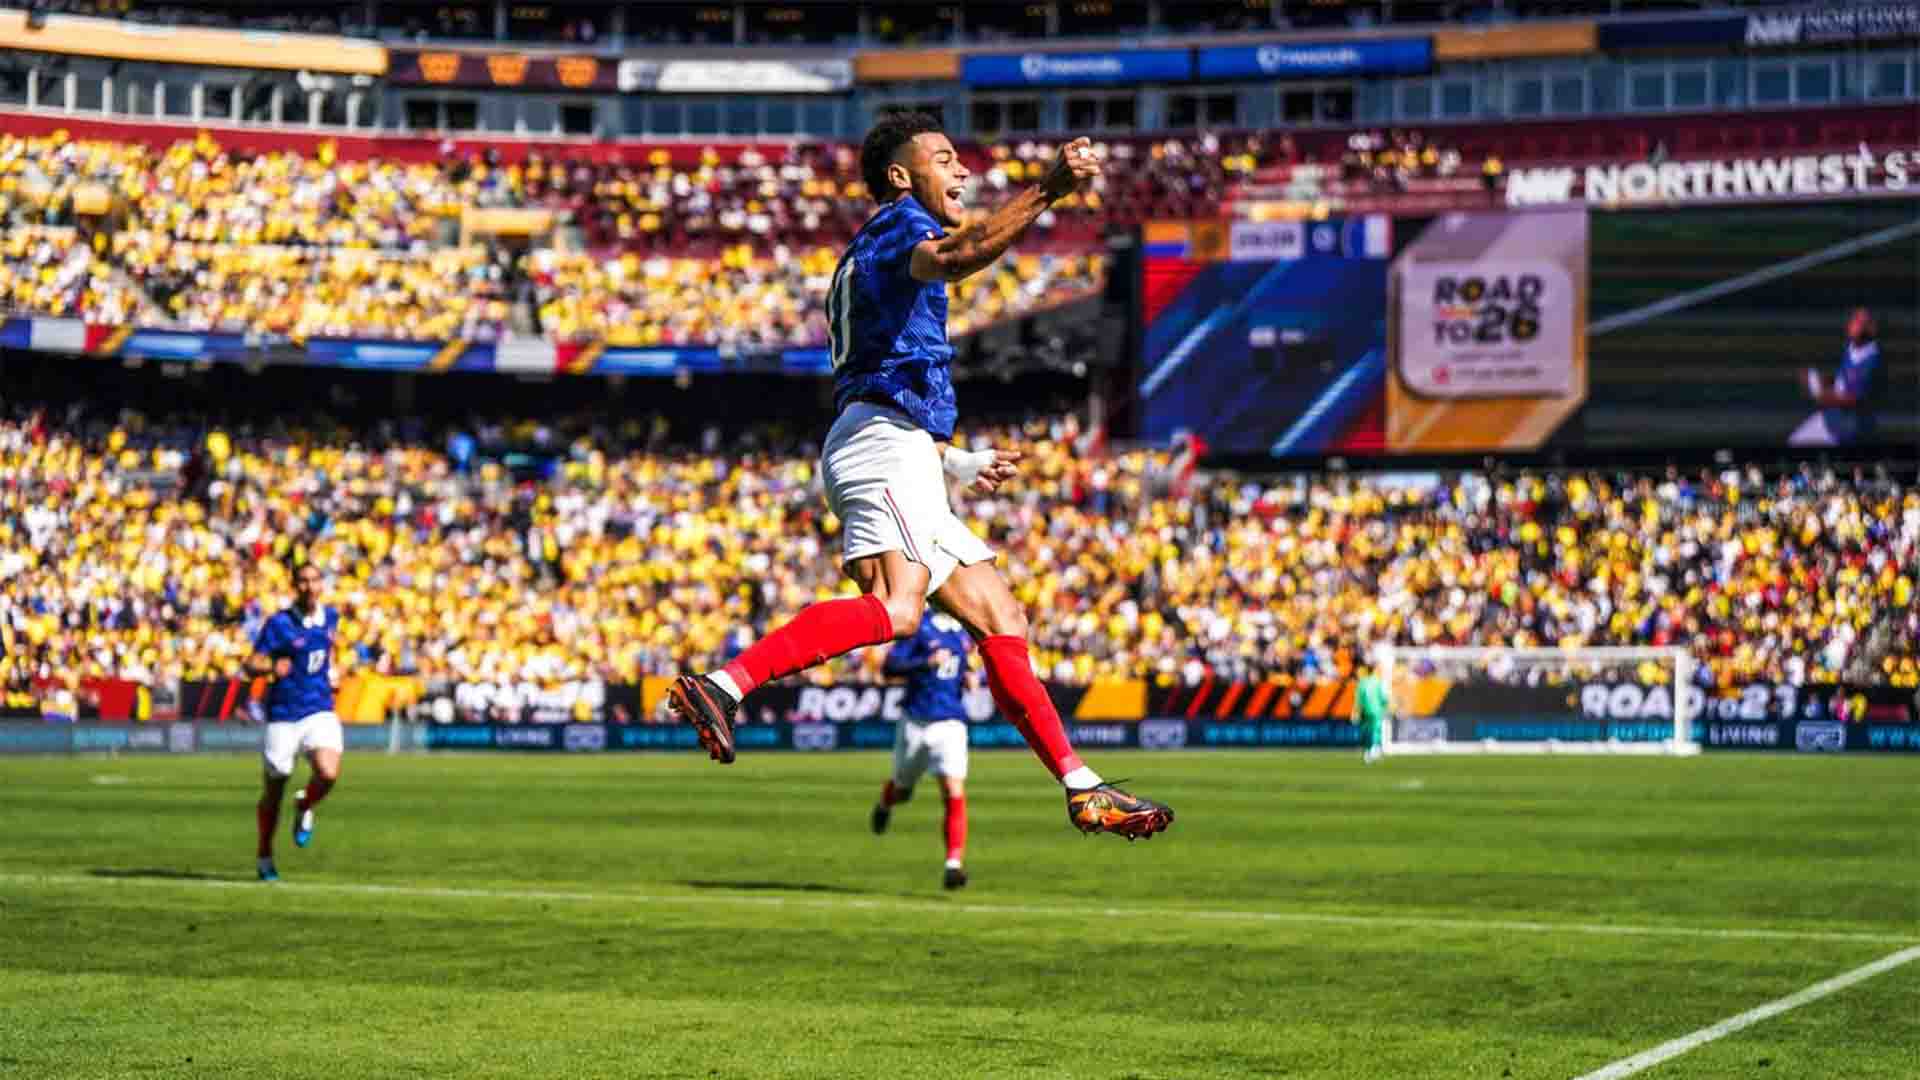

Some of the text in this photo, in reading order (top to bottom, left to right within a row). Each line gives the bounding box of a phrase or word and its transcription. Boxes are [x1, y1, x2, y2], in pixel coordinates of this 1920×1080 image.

[1584, 152, 1876, 203] NORTHWEST
[1433, 275, 1543, 305] ROAD
[1433, 302, 1541, 345] TO 26
[1580, 683, 1706, 720] ROAD
